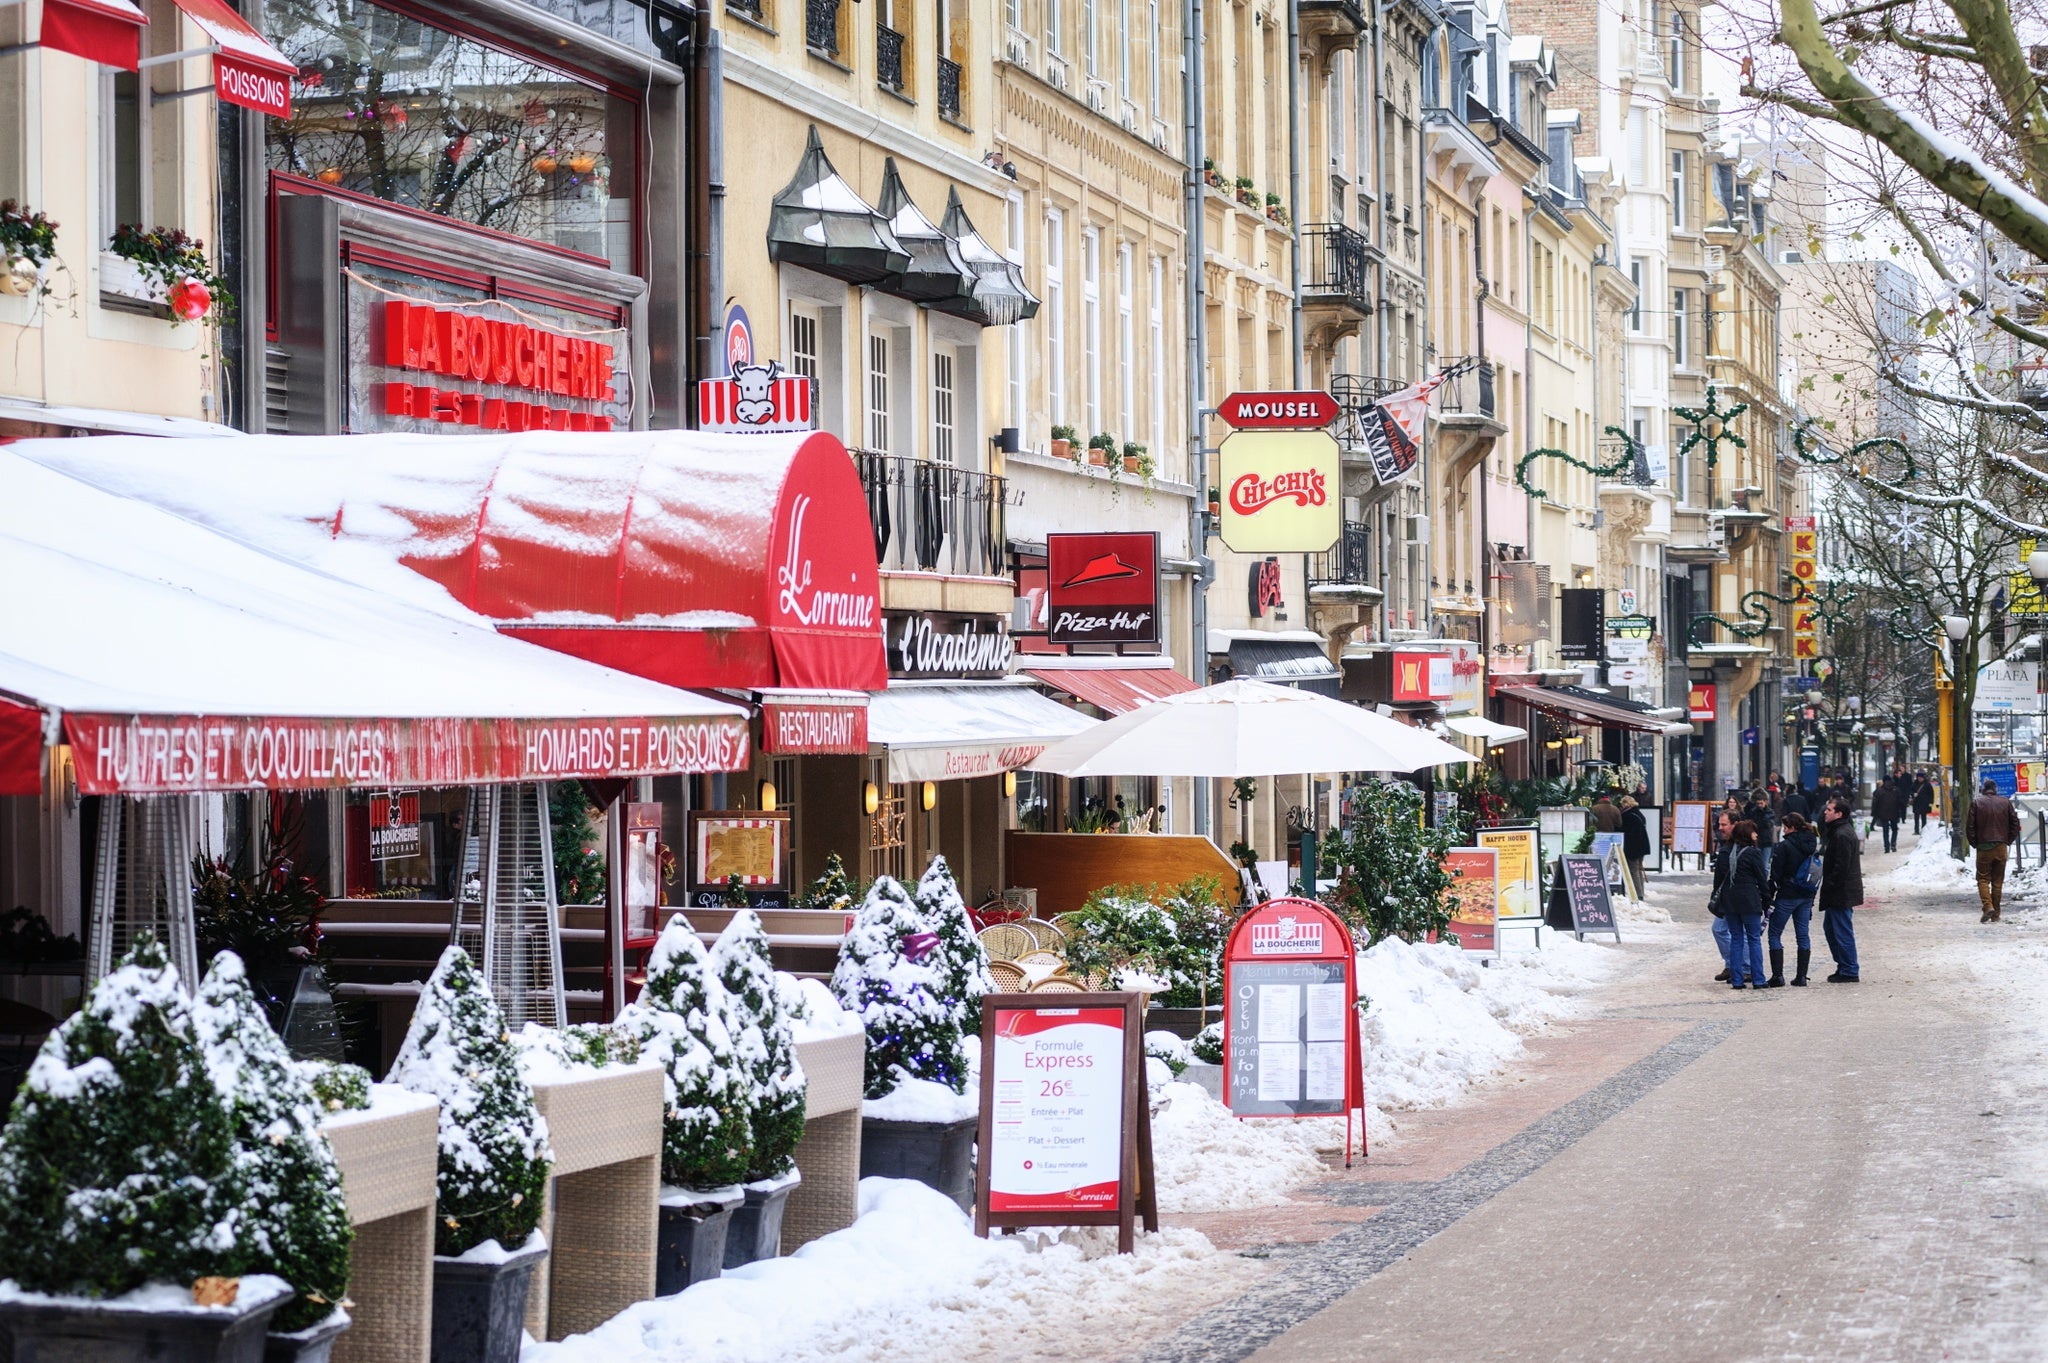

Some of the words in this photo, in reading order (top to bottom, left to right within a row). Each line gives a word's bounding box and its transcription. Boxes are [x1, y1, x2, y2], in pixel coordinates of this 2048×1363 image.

[221, 65, 284, 108] POISSONS
[396, 301, 443, 373] LA
[446, 312, 614, 401] BOUCHERIE
[1238, 402, 1320, 418] MOUSEL
[780, 497, 874, 629] Lorraine
[1054, 612, 1108, 634] Pizza
[1109, 611, 1151, 631] Hut
[779, 711, 854, 747] RESTAURANT
[206, 727, 234, 781] ET
[244, 727, 383, 781] COQUILLAGES
[525, 726, 614, 773] HOMARDS
[620, 727, 641, 770] ET
[650, 723, 732, 769] POISSONS
[945, 751, 990, 775] Restaurant
[371, 830, 381, 845] LA
[381, 827, 419, 844] BOUCHERIE
[1485, 835, 1506, 843] HAPPY
[1507, 834, 1527, 842] HOURS
[1267, 940, 1320, 948] BOUCHERIE
[1241, 964, 1271, 977] Menu
[1277, 965, 1288, 976] in
[1292, 963, 1341, 984] English
[1034, 1040, 1084, 1051] Formule
[1025, 1051, 1094, 1072] Express
[1238, 1058, 1254, 1072] to
[1031, 1107, 1059, 1117] Entrée
[1068, 1107, 1084, 1116] Plat
[1028, 1136, 1044, 1145] Plat
[1053, 1136, 1085, 1145] Dessert
[1044, 1161, 1057, 1169] Eau
[1058, 1160, 1088, 1169] minérale
